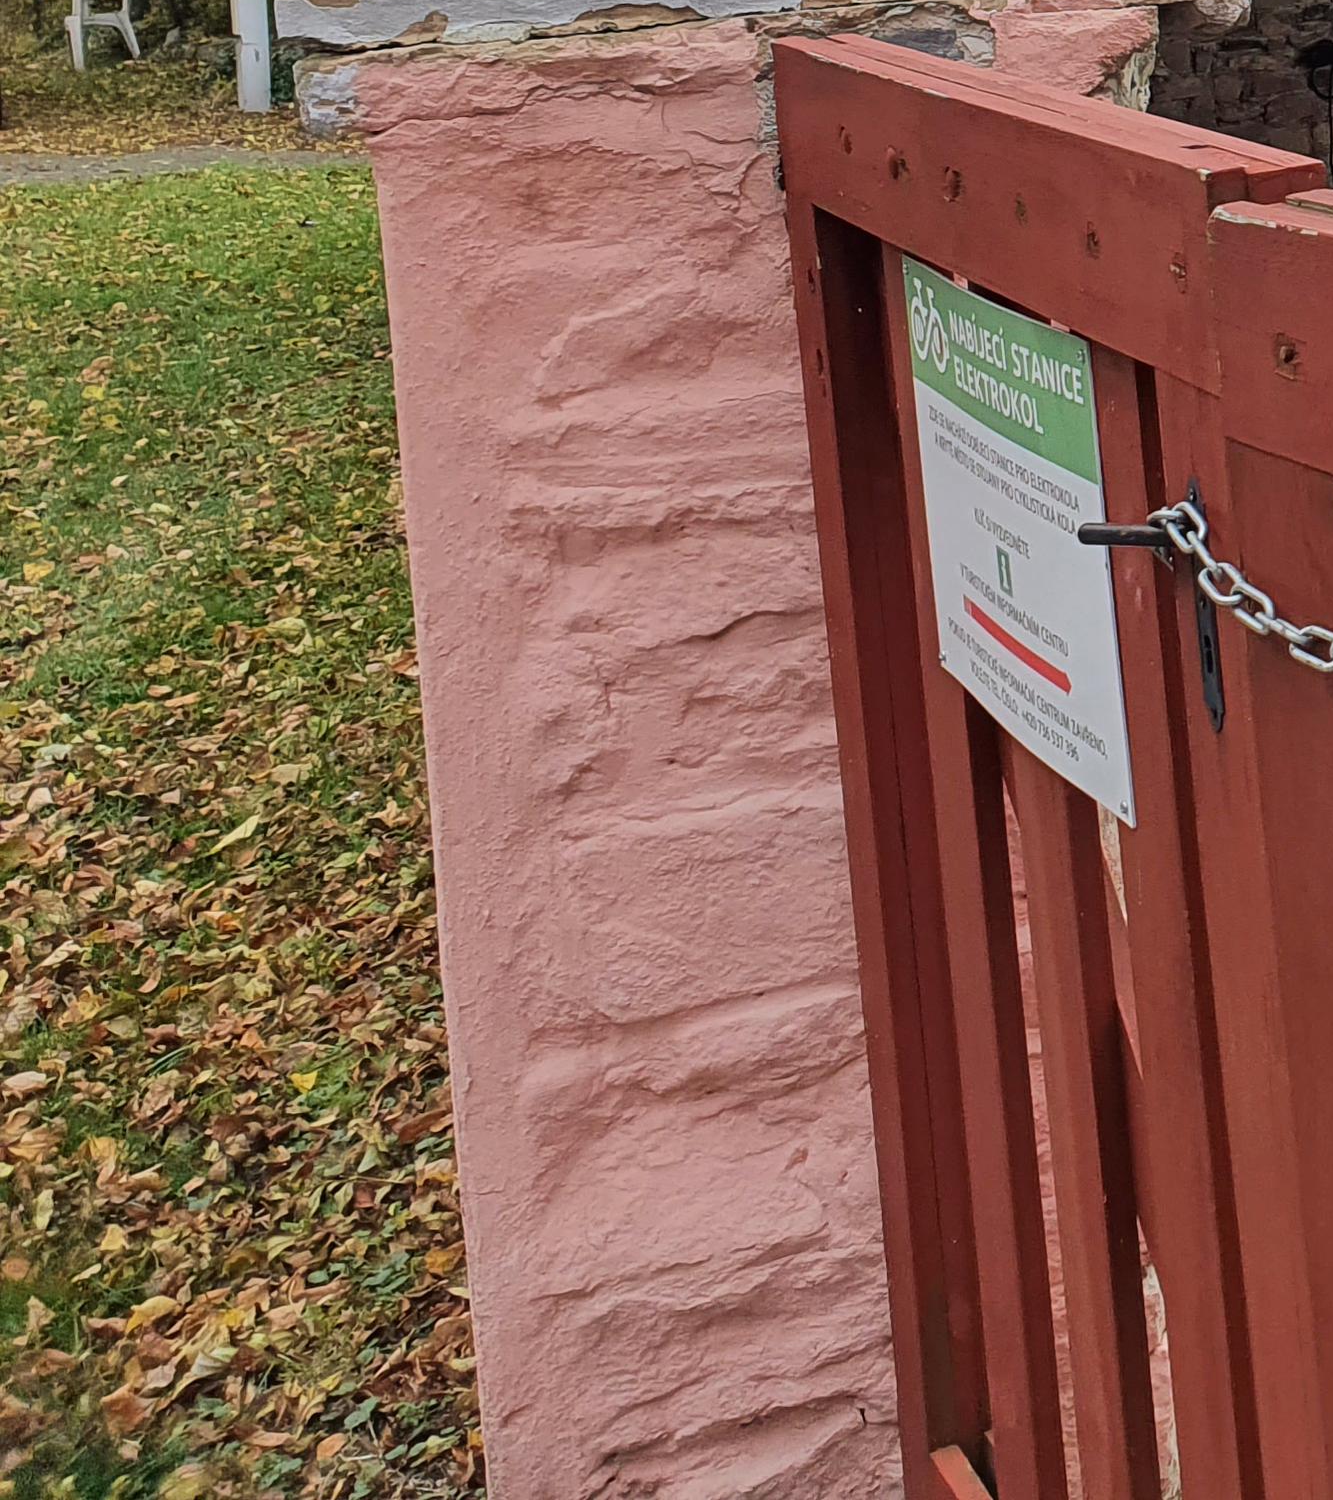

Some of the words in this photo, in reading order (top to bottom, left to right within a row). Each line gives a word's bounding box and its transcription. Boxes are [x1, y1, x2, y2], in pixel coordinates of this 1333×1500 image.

[948, 311, 1006, 372] NABÍJECÍ
[1010, 342, 1083, 405] STANICE
[954, 356, 1044, 434] ELEKTROKOL
[1041, 626, 1068, 657] CENTRU
[1036, 693, 1069, 731] CENTRUM
